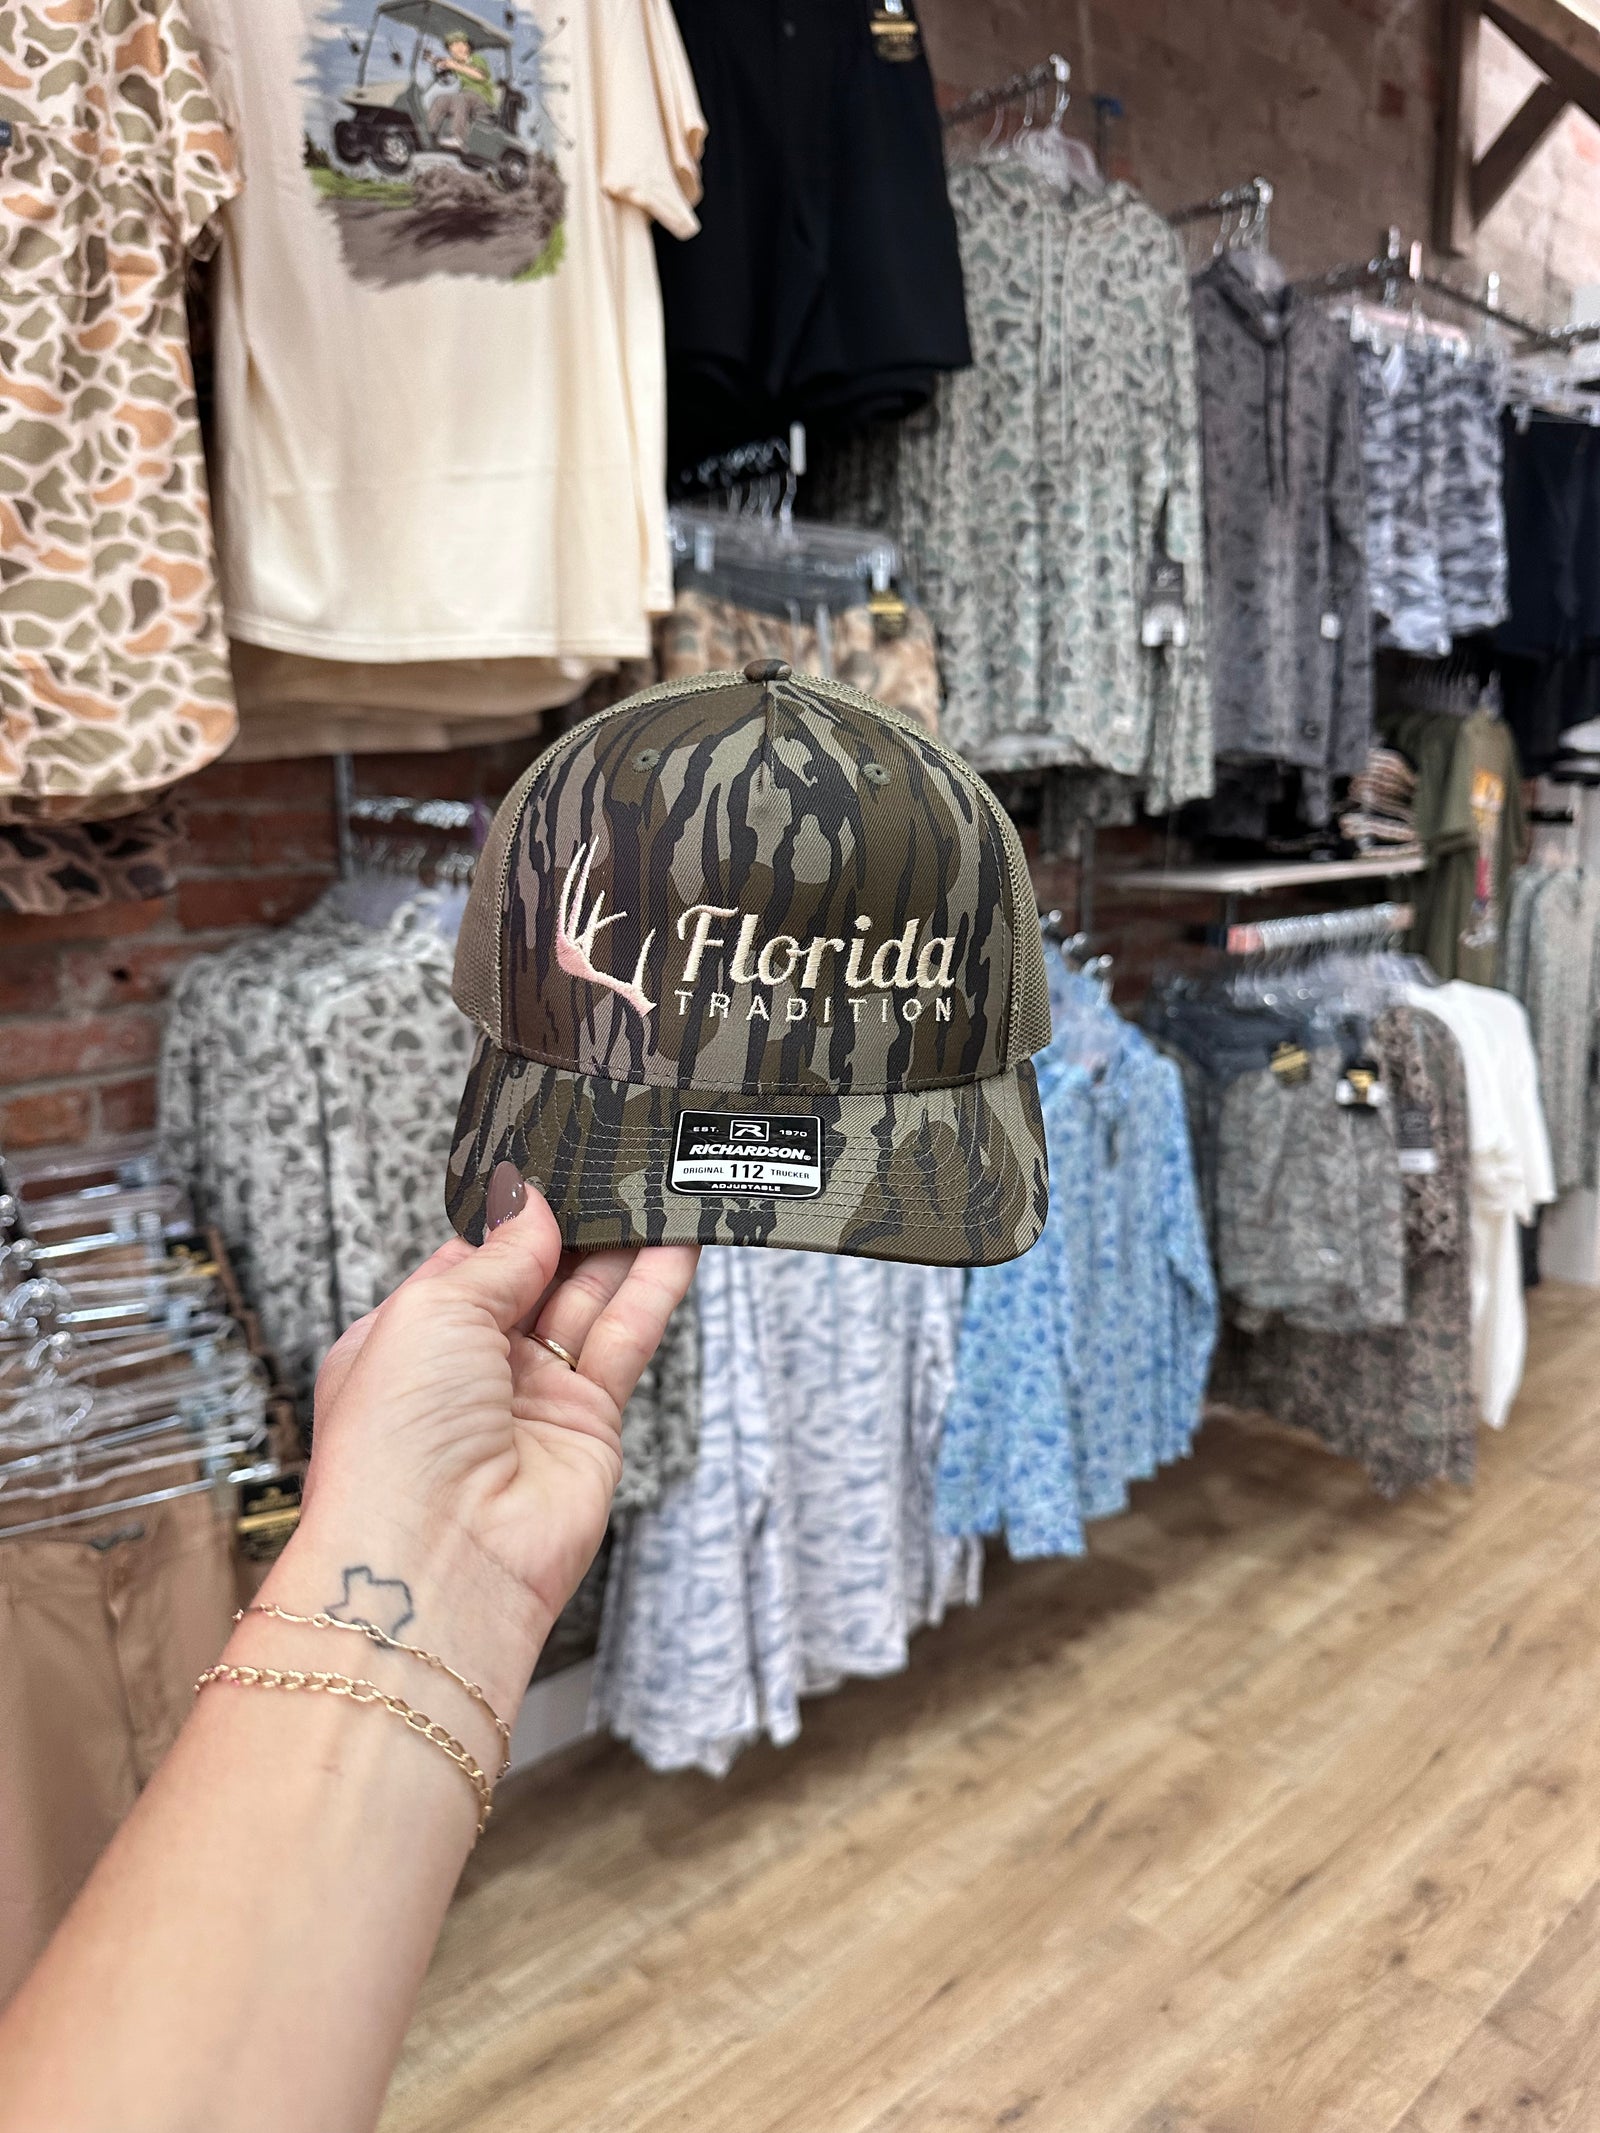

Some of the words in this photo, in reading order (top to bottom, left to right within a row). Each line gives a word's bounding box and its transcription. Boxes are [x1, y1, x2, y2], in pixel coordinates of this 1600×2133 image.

[677, 904, 956, 988] Florida
[674, 989, 952, 1023] TRADITION
[779, 1129, 808, 1138] 1970
[683, 1167, 725, 1175] ORIGINAL
[730, 1163, 764, 1179] 112
[770, 1168, 810, 1179] TRUCKER
[711, 1183, 781, 1192] ADJUSTABLE
